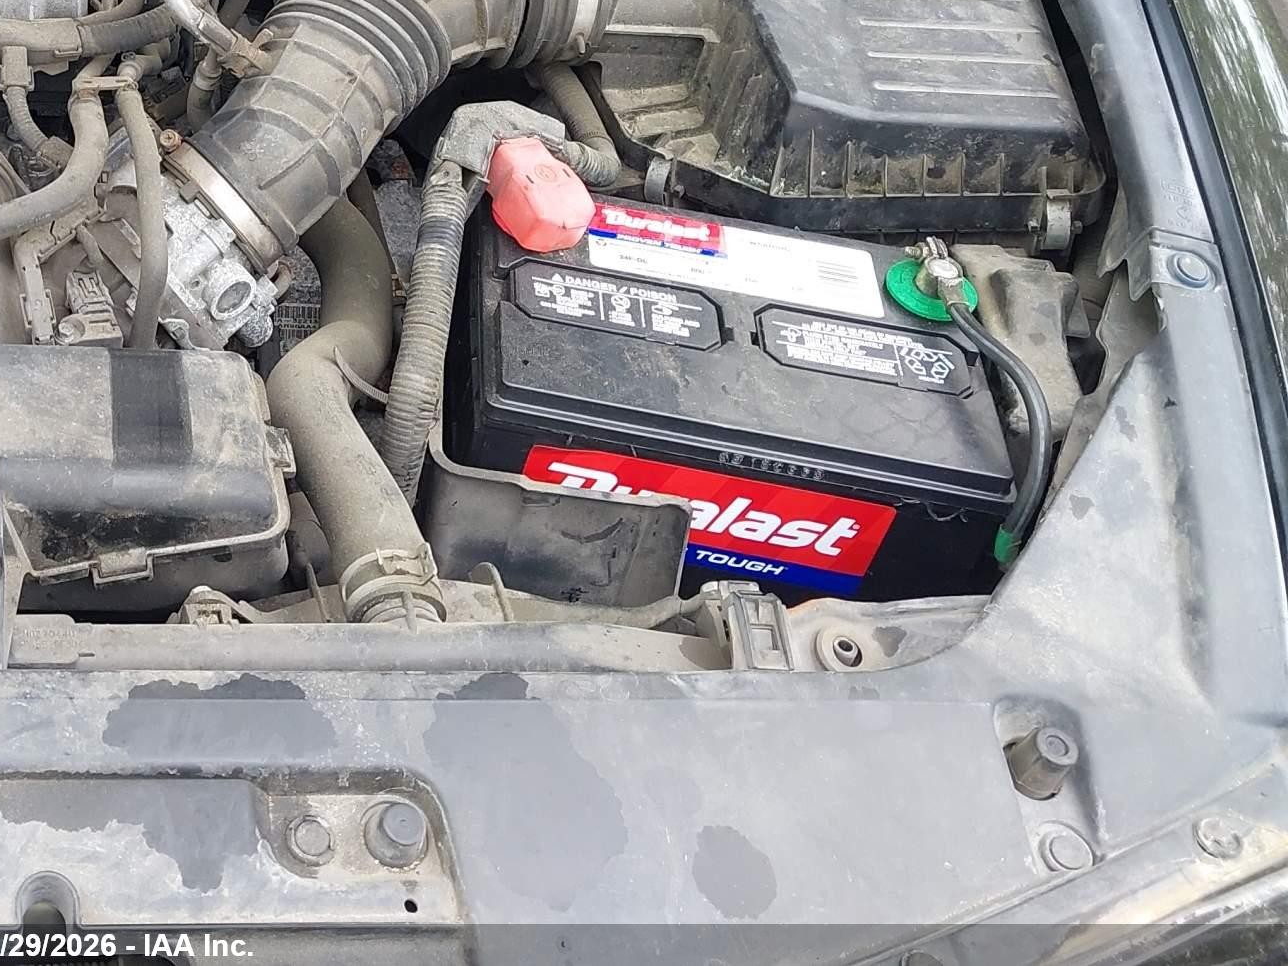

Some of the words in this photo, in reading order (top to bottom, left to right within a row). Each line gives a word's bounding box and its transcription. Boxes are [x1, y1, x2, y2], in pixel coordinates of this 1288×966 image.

[565, 275, 617, 293] DANGER
[629, 287, 677, 303] POISON
[695, 549, 785, 575] TOUGH
